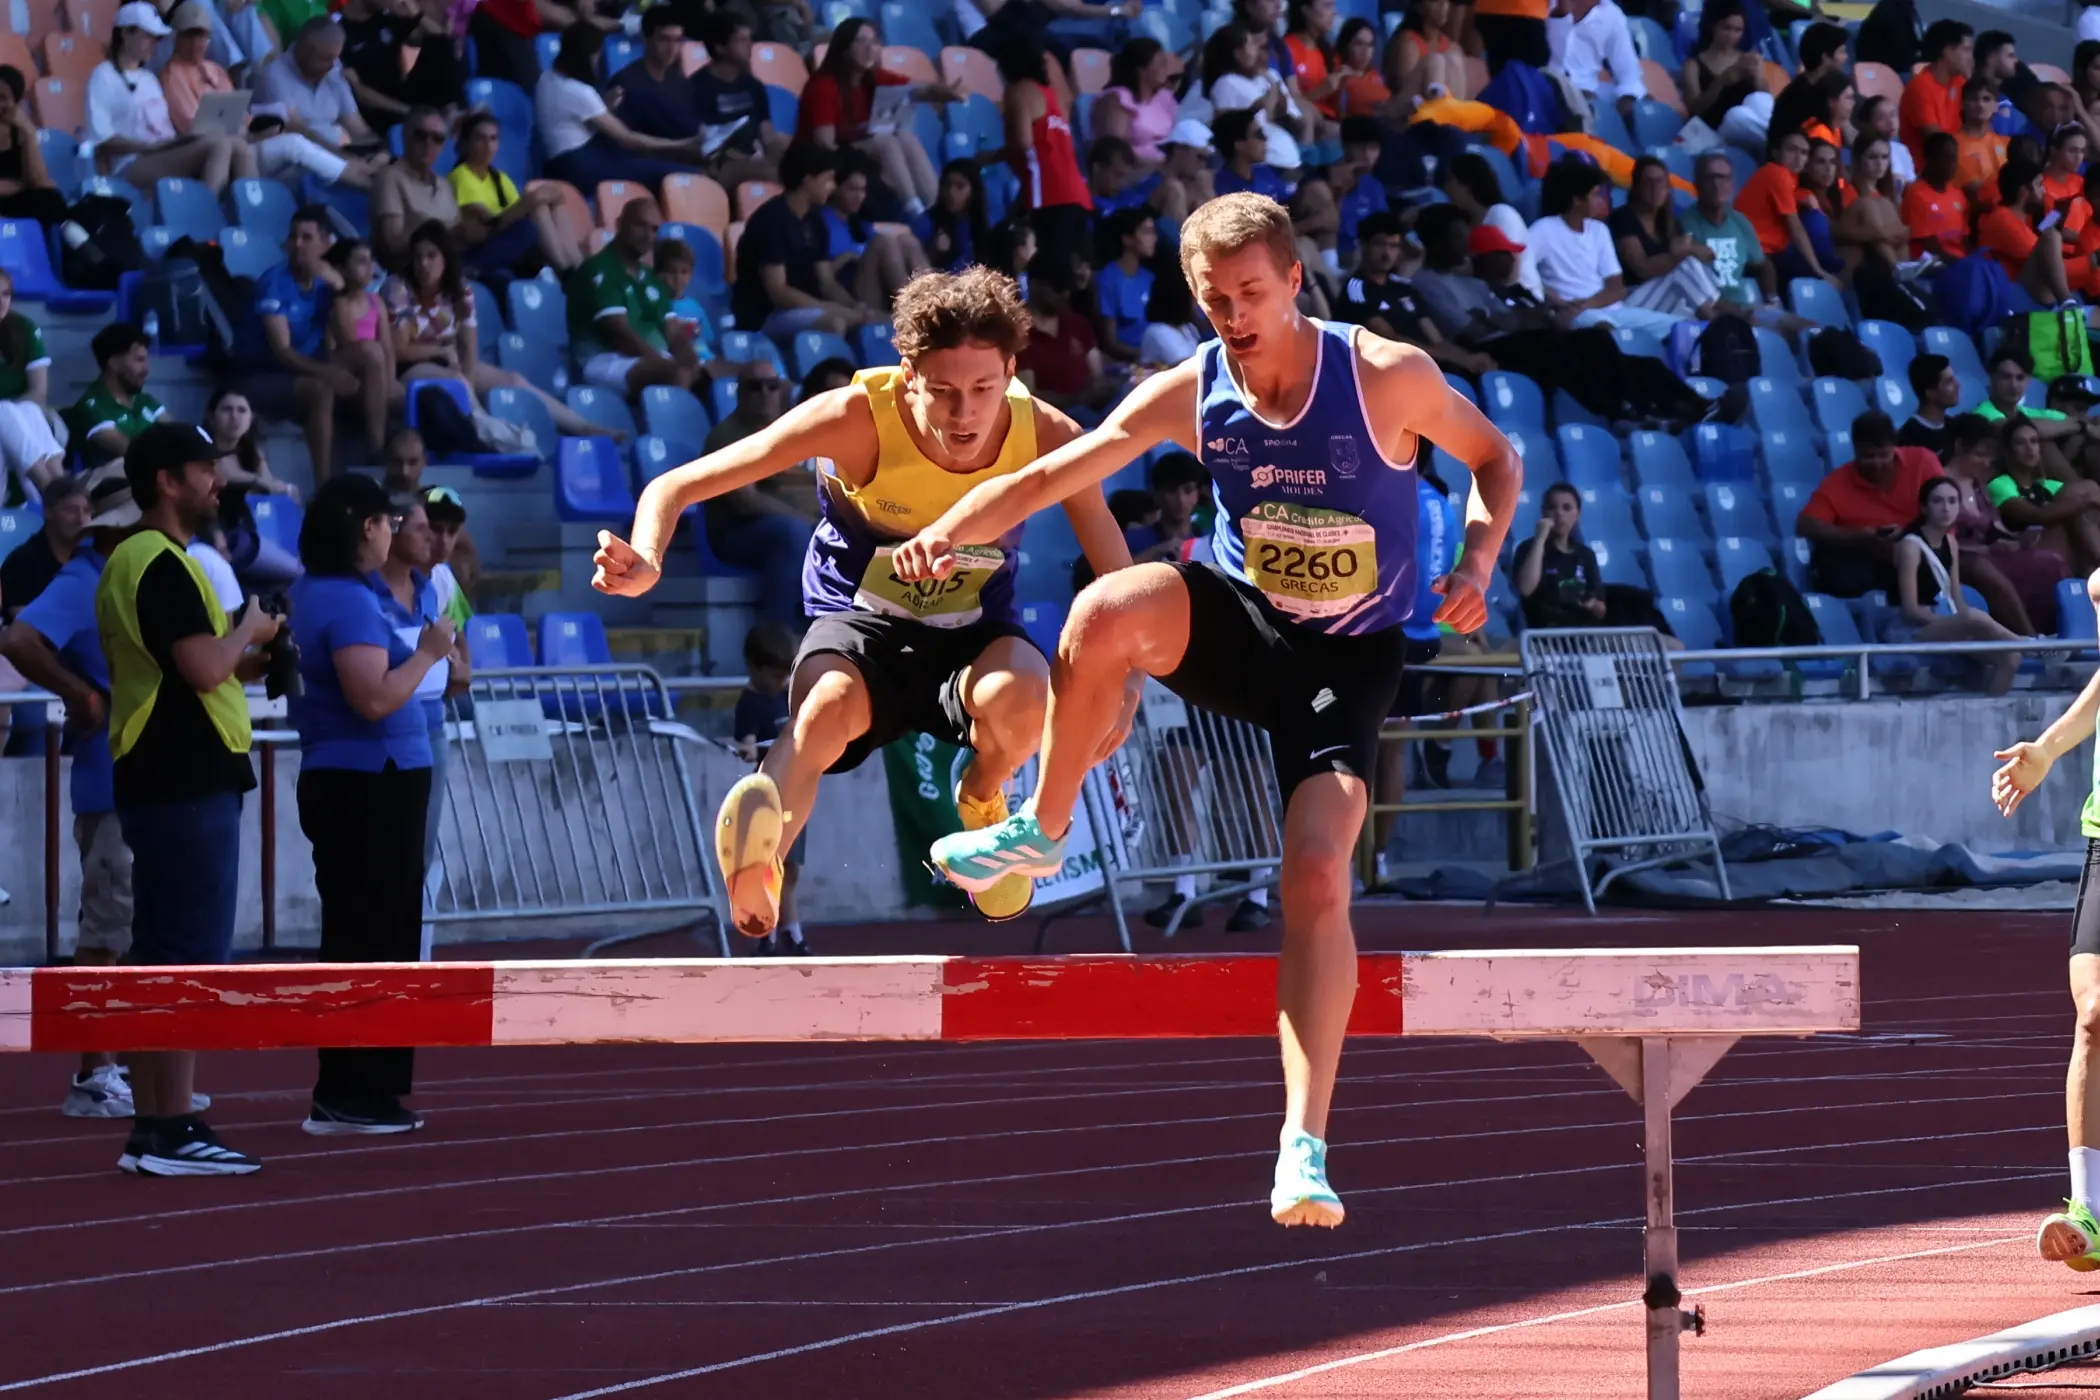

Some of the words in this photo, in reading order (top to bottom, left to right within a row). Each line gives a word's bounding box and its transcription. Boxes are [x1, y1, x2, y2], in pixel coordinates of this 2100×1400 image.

[1225, 437, 1249, 455] CA
[1275, 469, 1327, 485] PRIFER
[1263, 503, 1289, 520] CA
[1260, 544, 1358, 580] 2260
[1280, 578, 1339, 593] GRECAS
[1633, 972, 1802, 1008] DIMA
